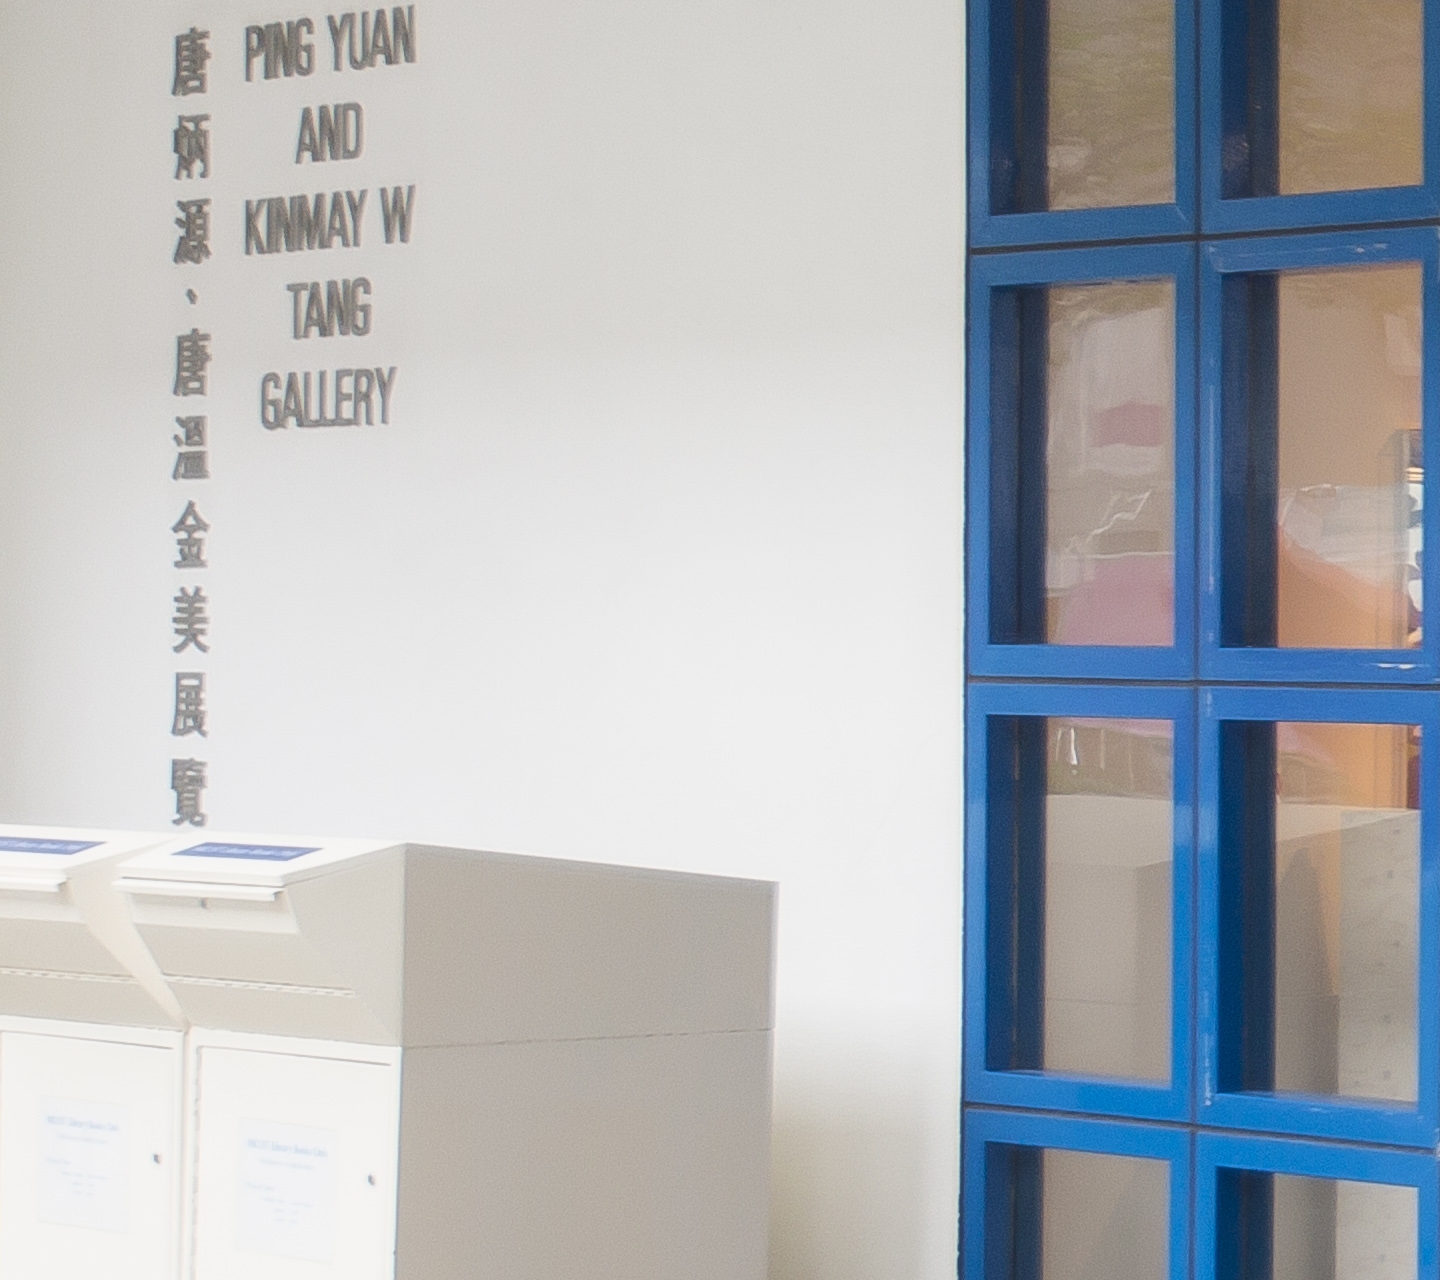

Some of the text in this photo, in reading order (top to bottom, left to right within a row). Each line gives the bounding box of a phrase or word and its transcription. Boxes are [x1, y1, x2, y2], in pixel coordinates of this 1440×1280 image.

[245, 5, 415, 82] PING YUAN
[295, 102, 362, 164] AND
[244, 185, 415, 256] KINMAY W
[286, 277, 371, 340] TANG
[260, 366, 396, 431] GALLERY
